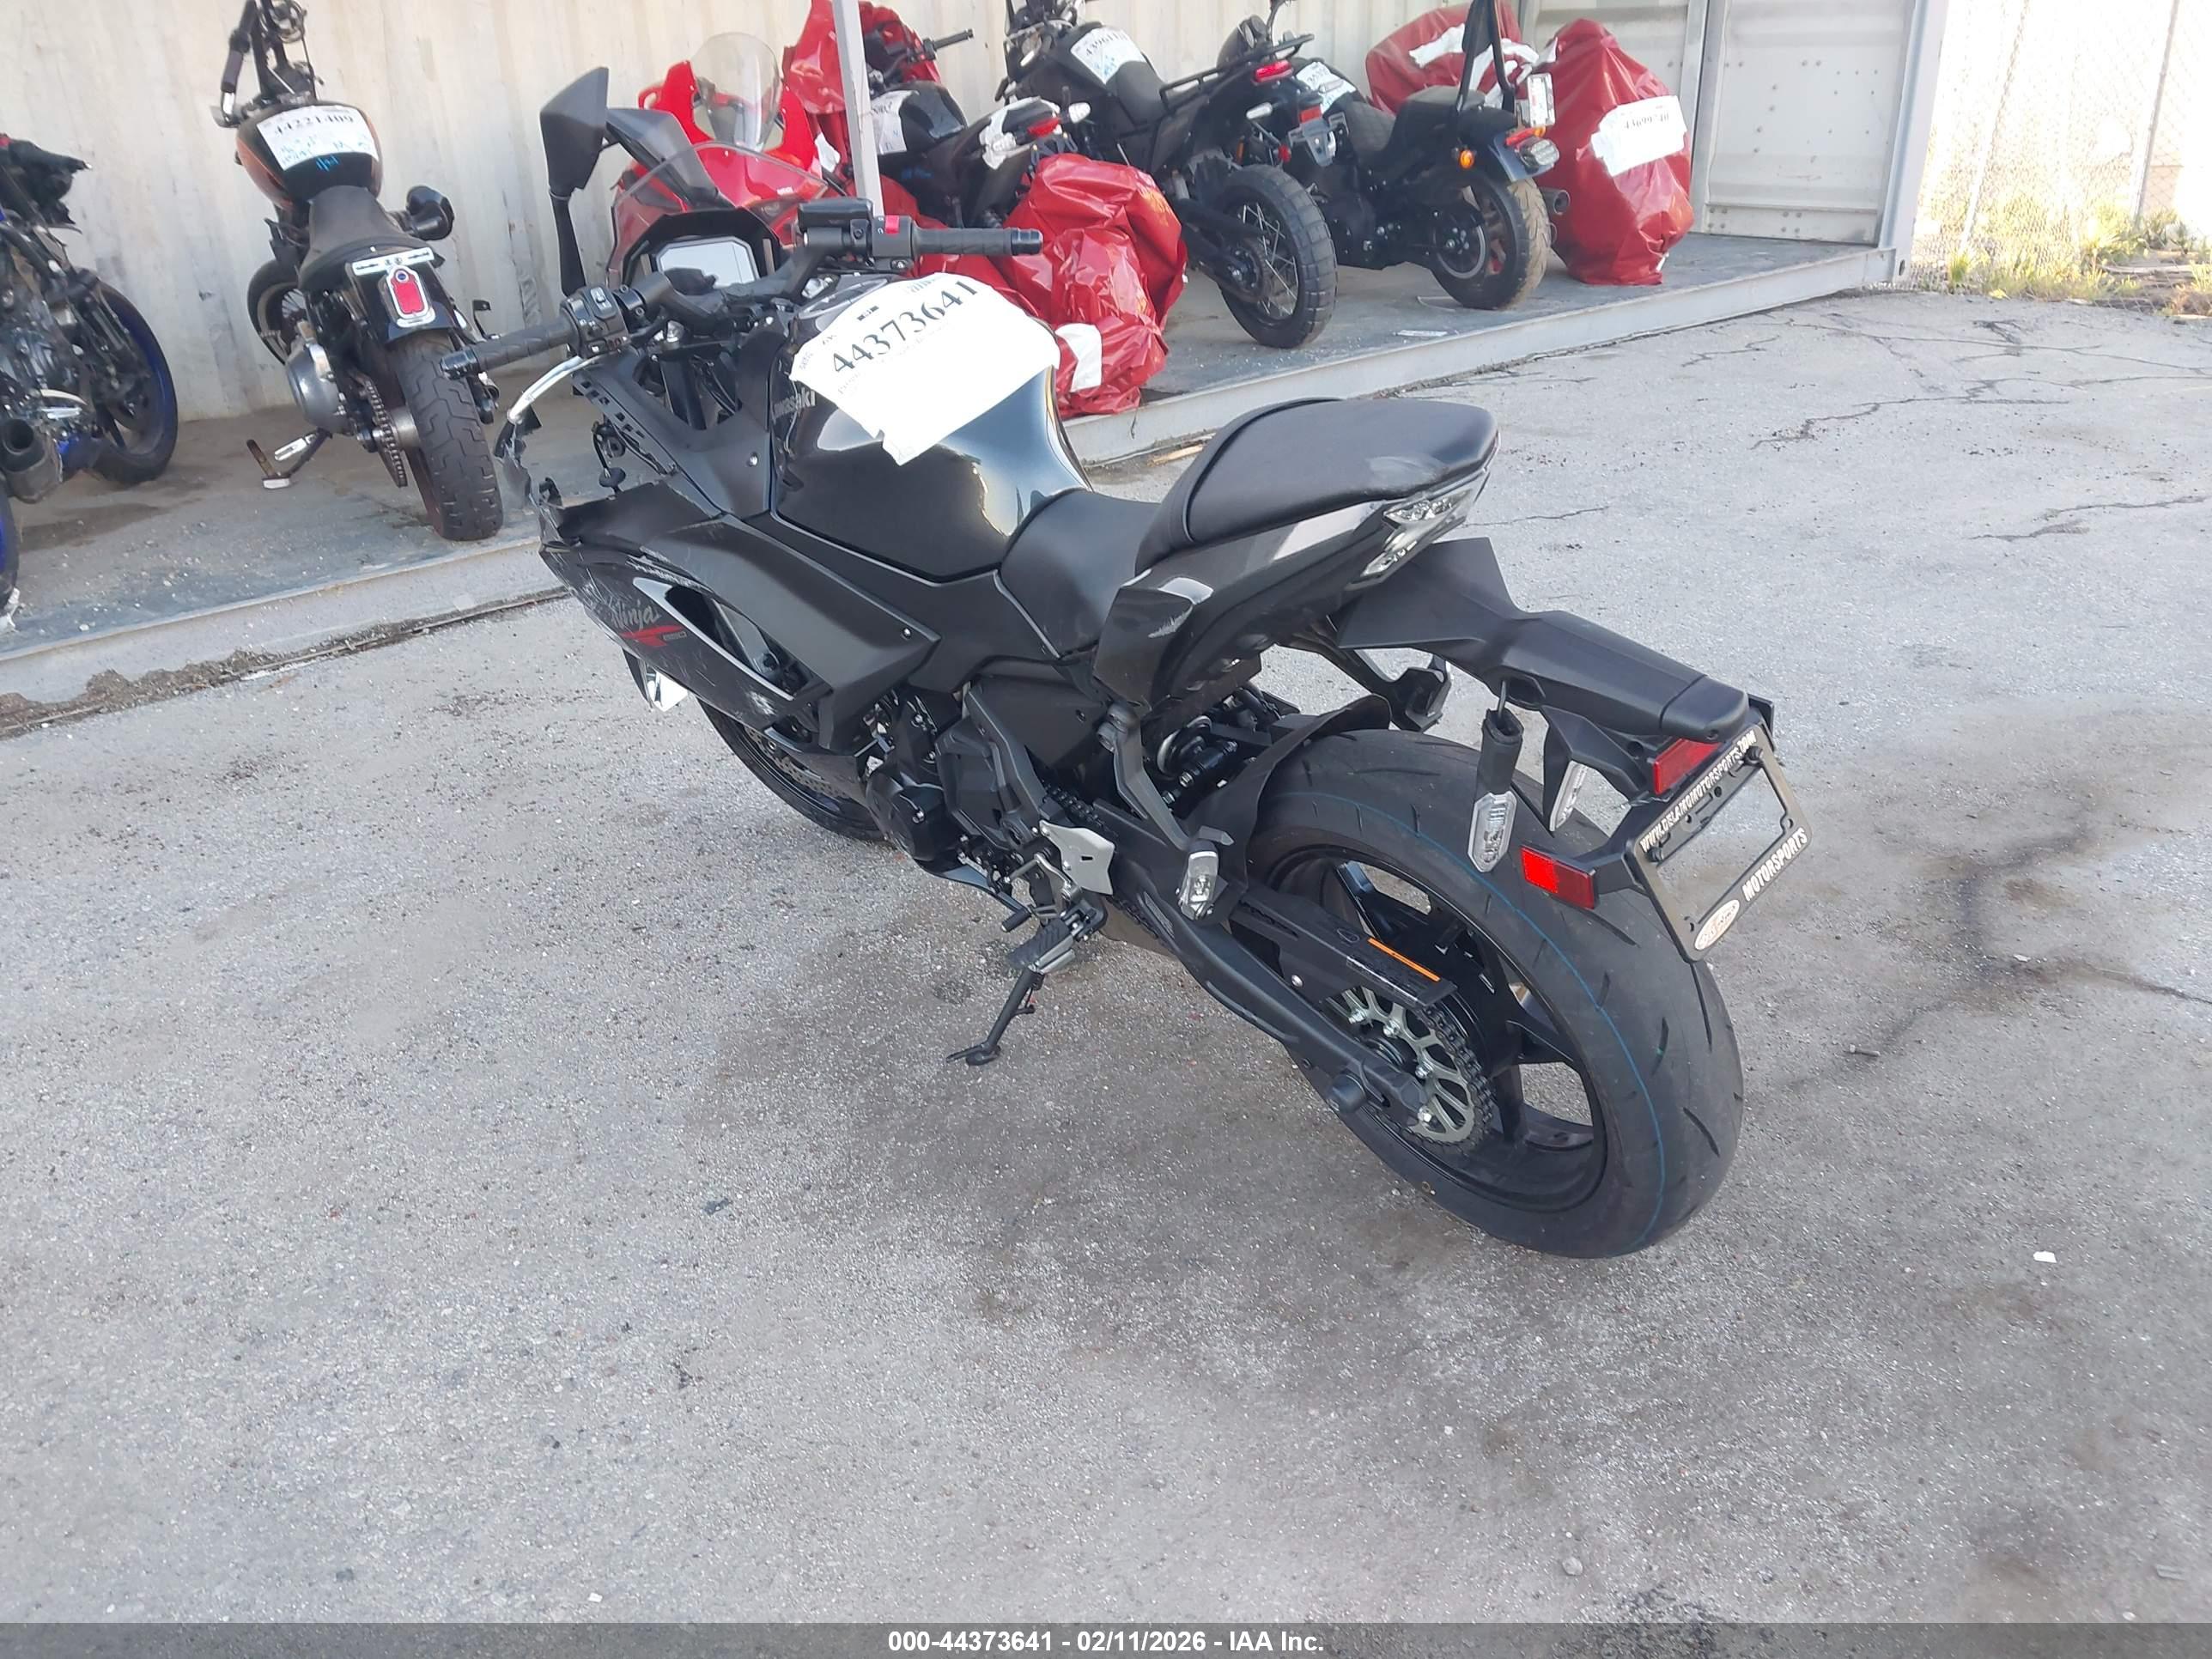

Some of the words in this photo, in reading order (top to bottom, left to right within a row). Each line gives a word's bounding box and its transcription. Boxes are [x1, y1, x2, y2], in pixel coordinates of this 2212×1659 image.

[832, 280, 978, 373] 44373641
[611, 598, 662, 632] Ninja
[1741, 827, 1808, 902] MOTORSPORTS
